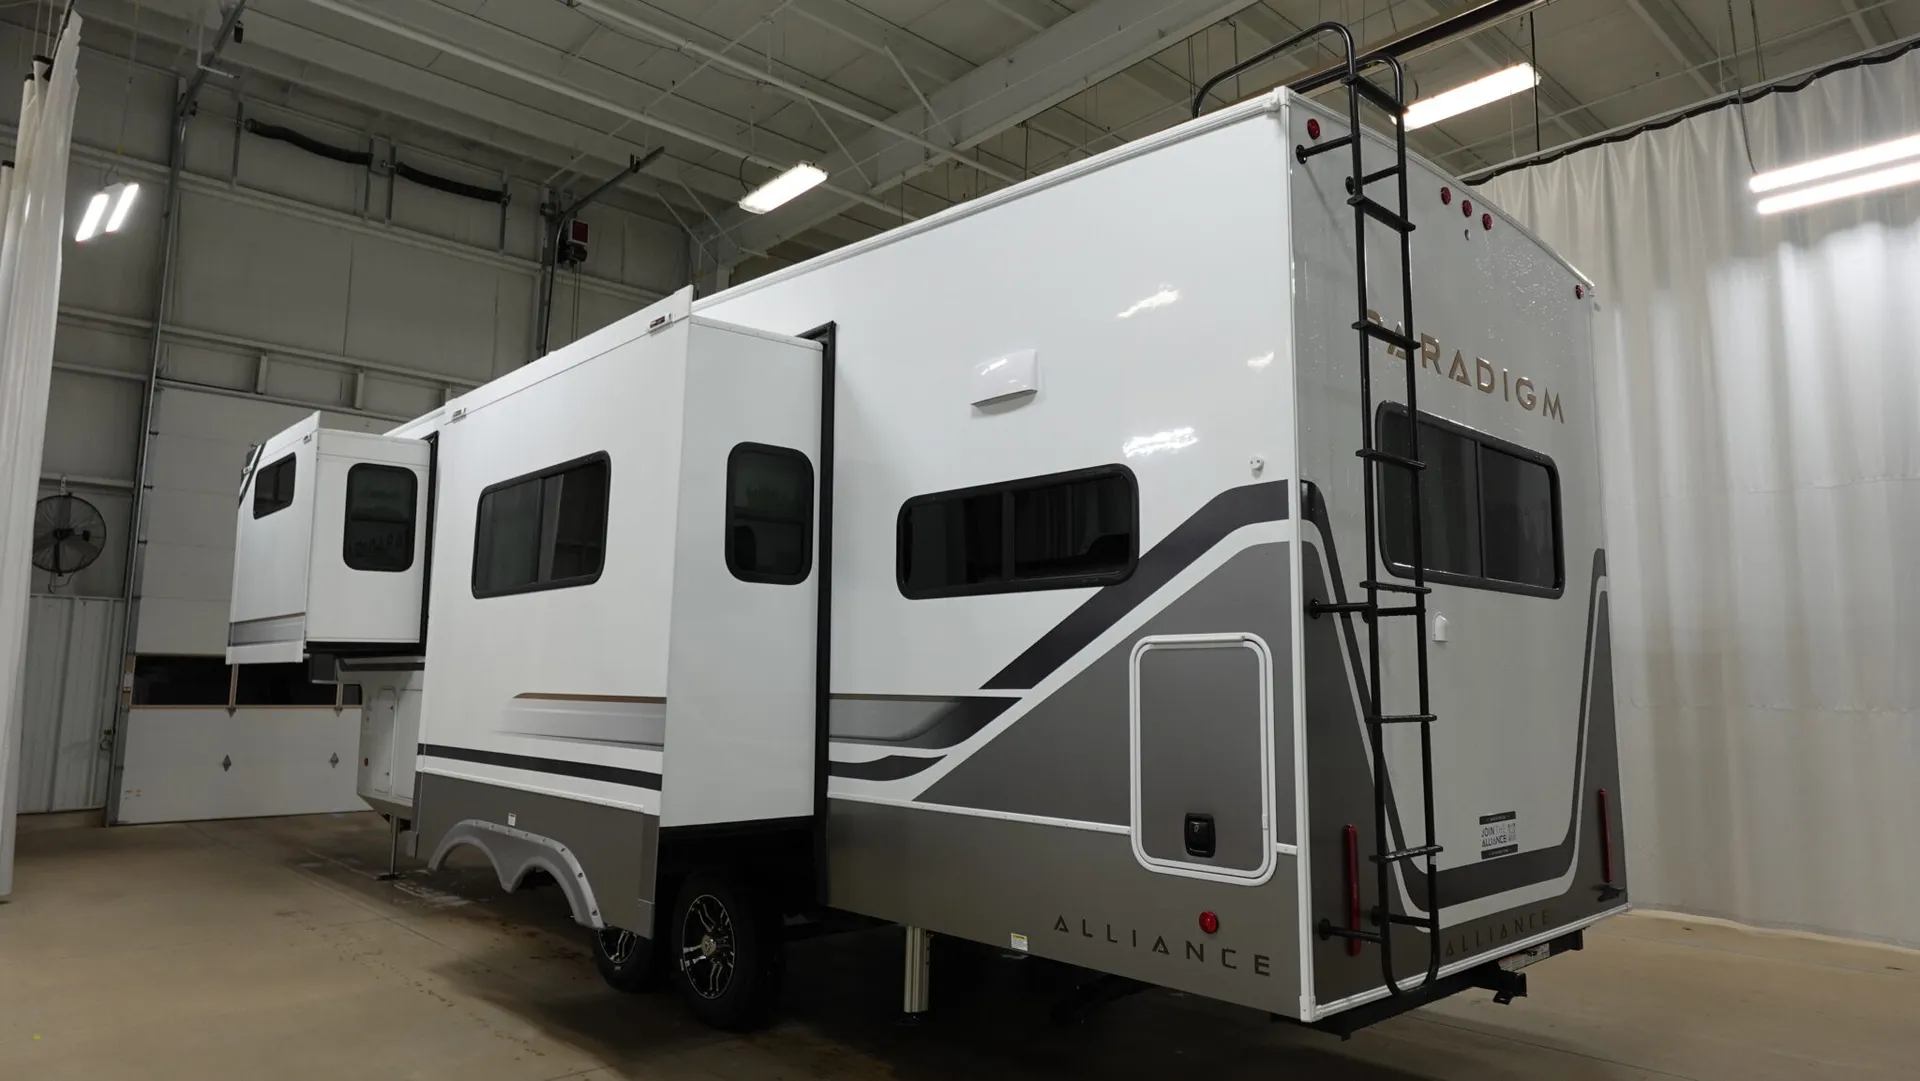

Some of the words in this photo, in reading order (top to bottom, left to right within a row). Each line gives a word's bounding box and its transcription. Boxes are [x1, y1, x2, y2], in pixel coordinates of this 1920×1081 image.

[1481, 835, 1507, 847] ALLIANCE
[1053, 914, 1271, 977] ALLIANCE
[1445, 909, 1550, 958] ALLIANCE
